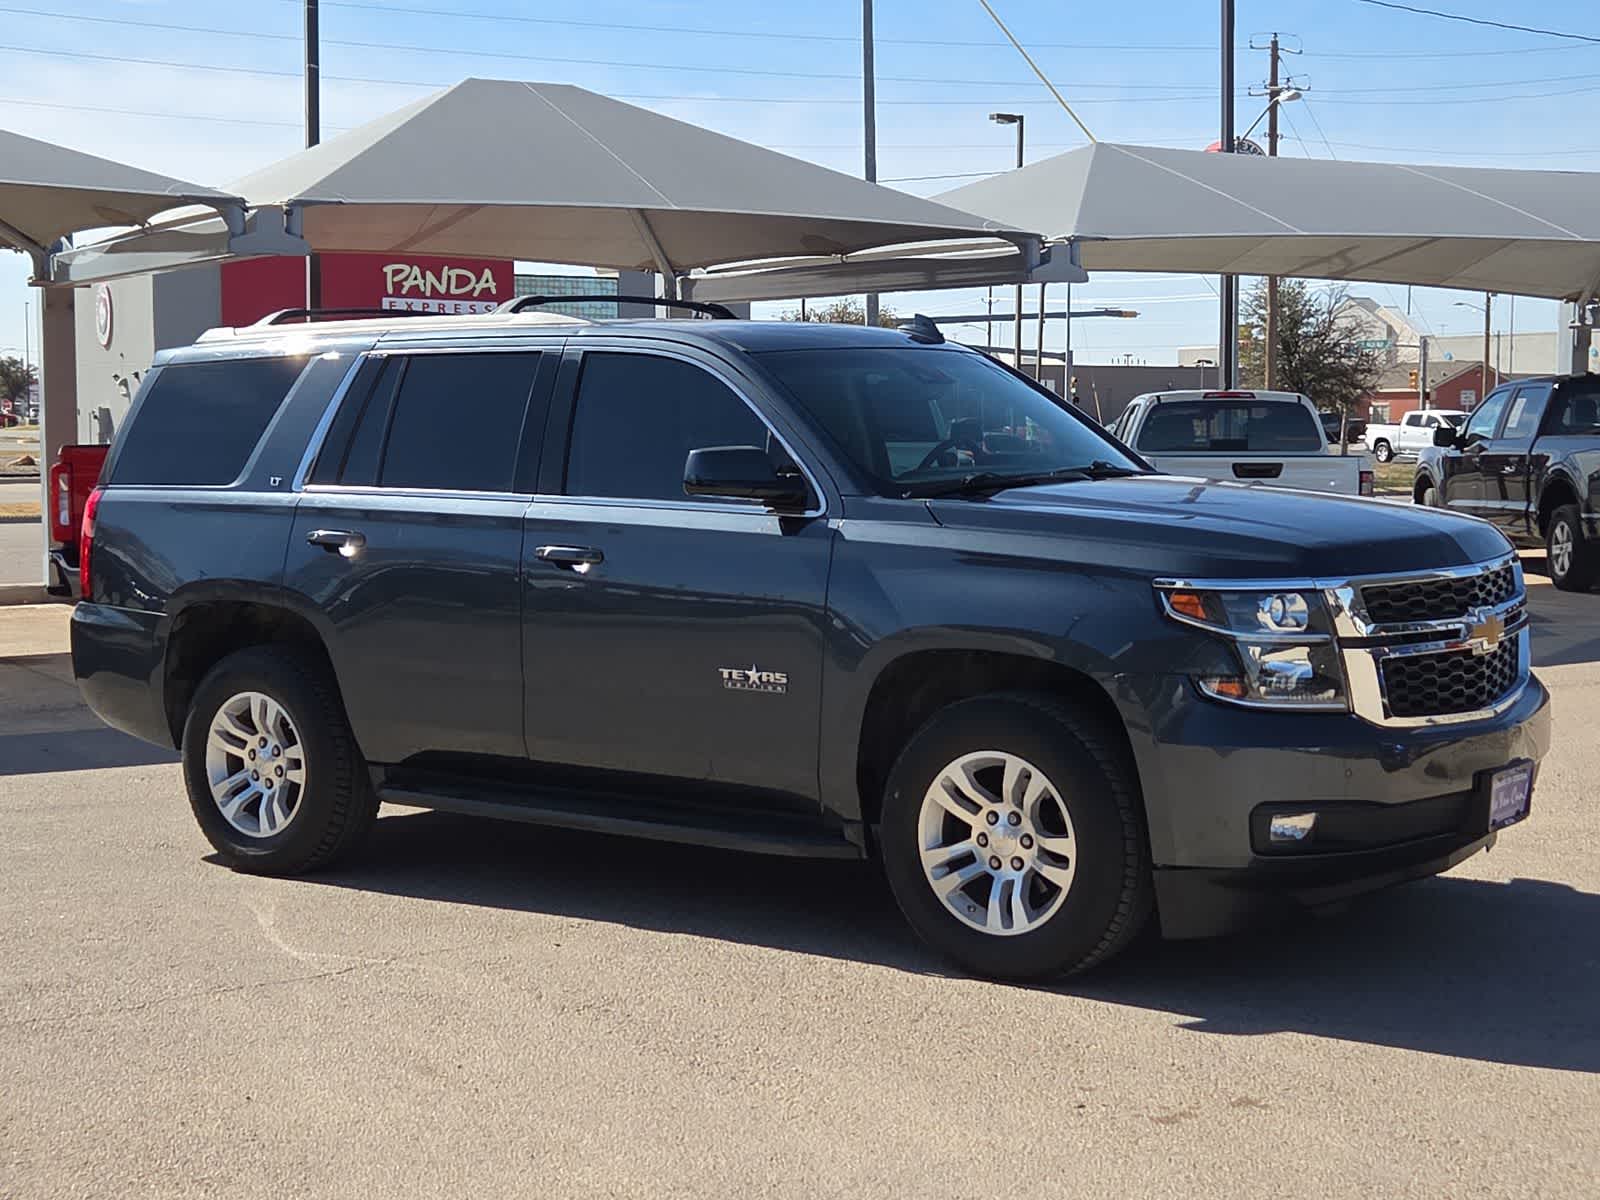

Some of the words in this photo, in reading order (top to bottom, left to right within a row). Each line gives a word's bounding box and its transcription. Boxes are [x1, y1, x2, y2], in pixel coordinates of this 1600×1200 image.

[382, 264, 497, 297] PANDA
[388, 301, 493, 314] EXPRESS
[270, 476, 282, 486] LT
[718, 664, 787, 685] TEXAS
